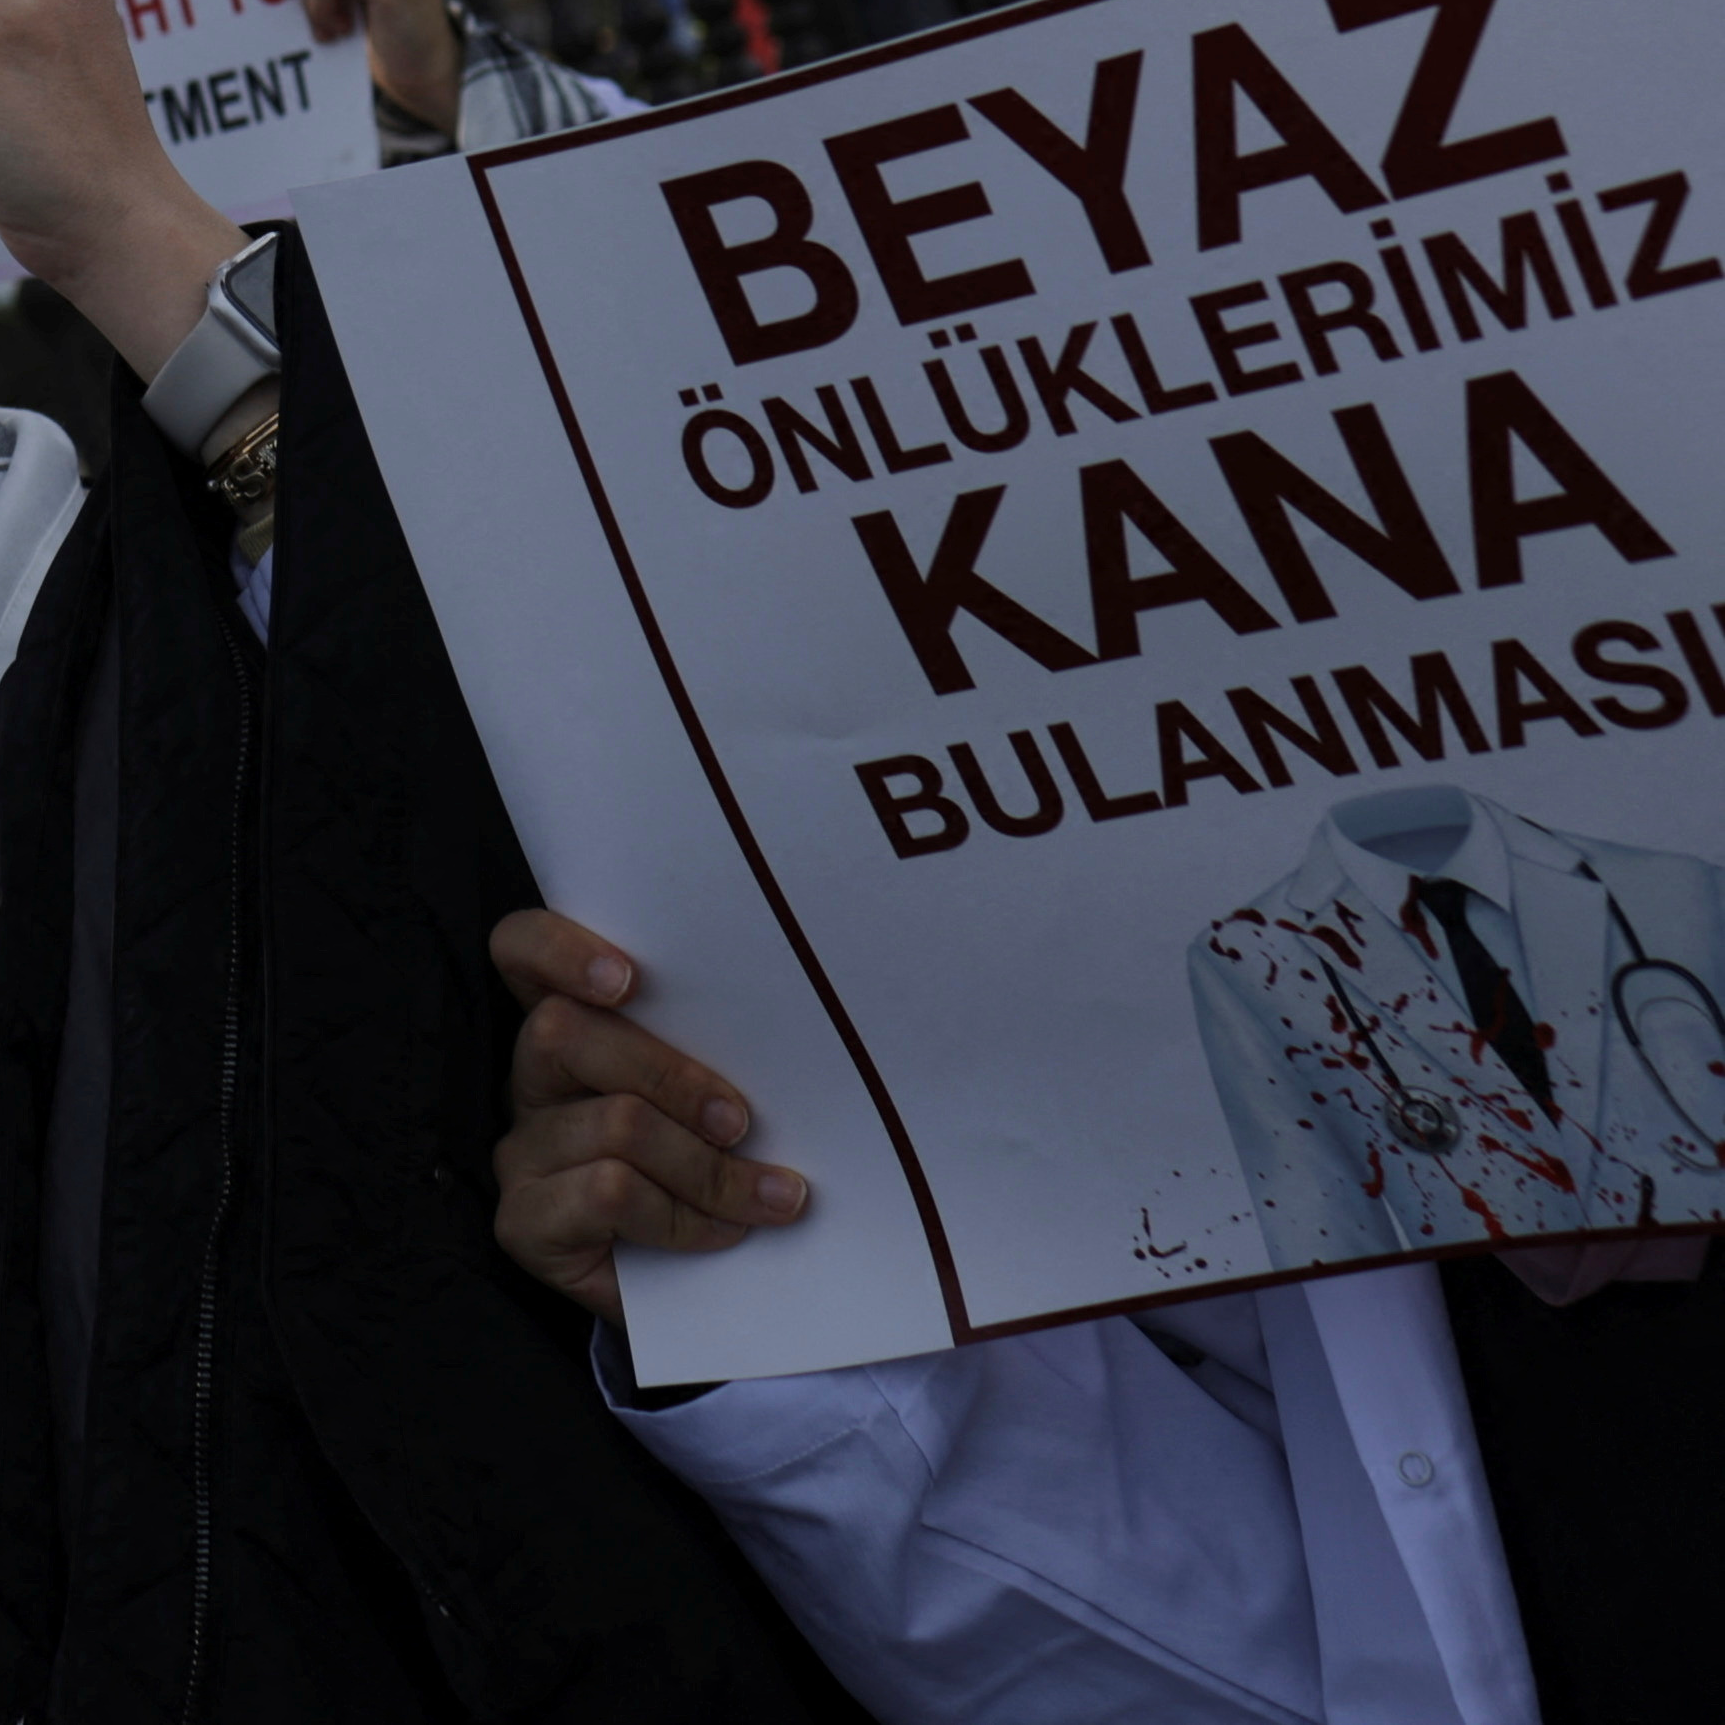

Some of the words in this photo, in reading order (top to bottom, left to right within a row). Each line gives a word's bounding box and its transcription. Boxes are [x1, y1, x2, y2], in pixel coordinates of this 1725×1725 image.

[679, 168, 1725, 510] ÖNLÜKLERİMİZ
[851, 368, 1676, 697] KANA
[853, 601, 1725, 859] BULANMASI
